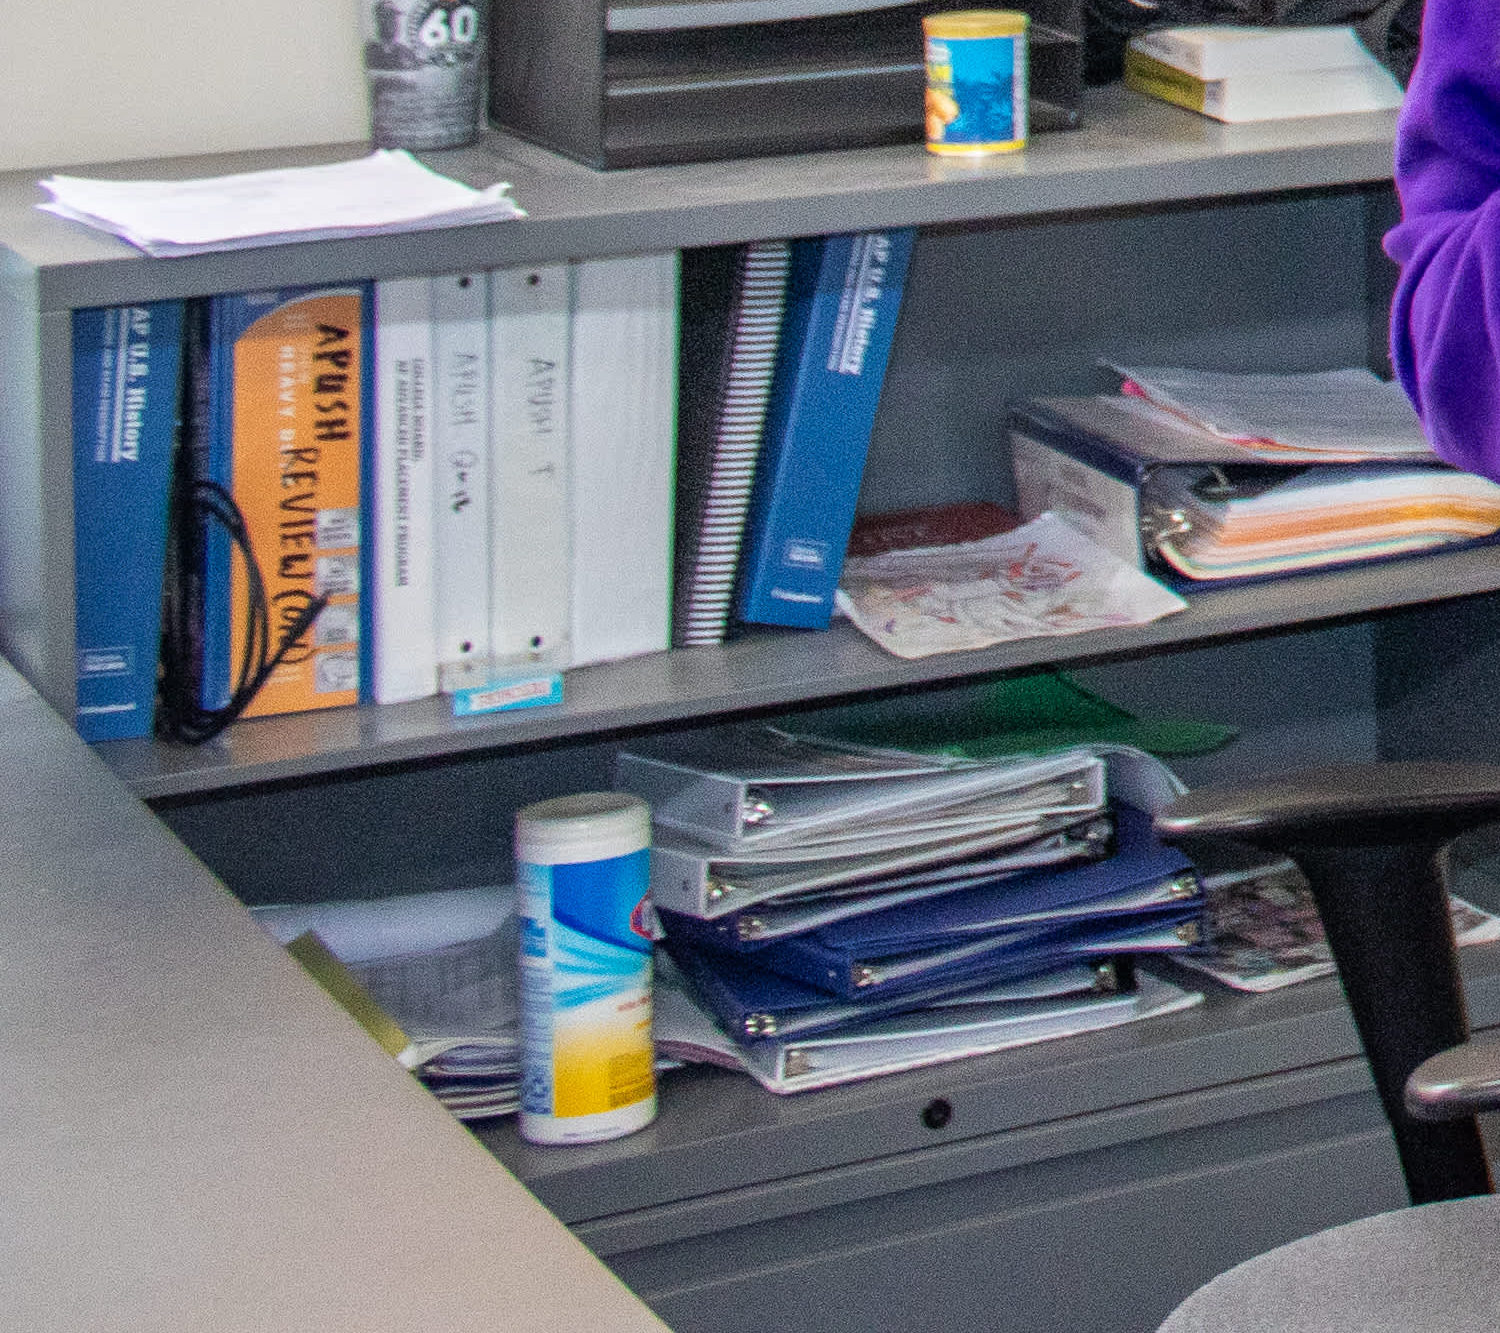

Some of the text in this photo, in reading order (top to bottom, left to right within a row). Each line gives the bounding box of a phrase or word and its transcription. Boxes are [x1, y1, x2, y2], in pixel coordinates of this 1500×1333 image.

[419, 5, 479, 48] 60
[122, 387, 149, 463] History
[314, 322, 354, 443] APUSH
[278, 446, 322, 581] REVIEW
